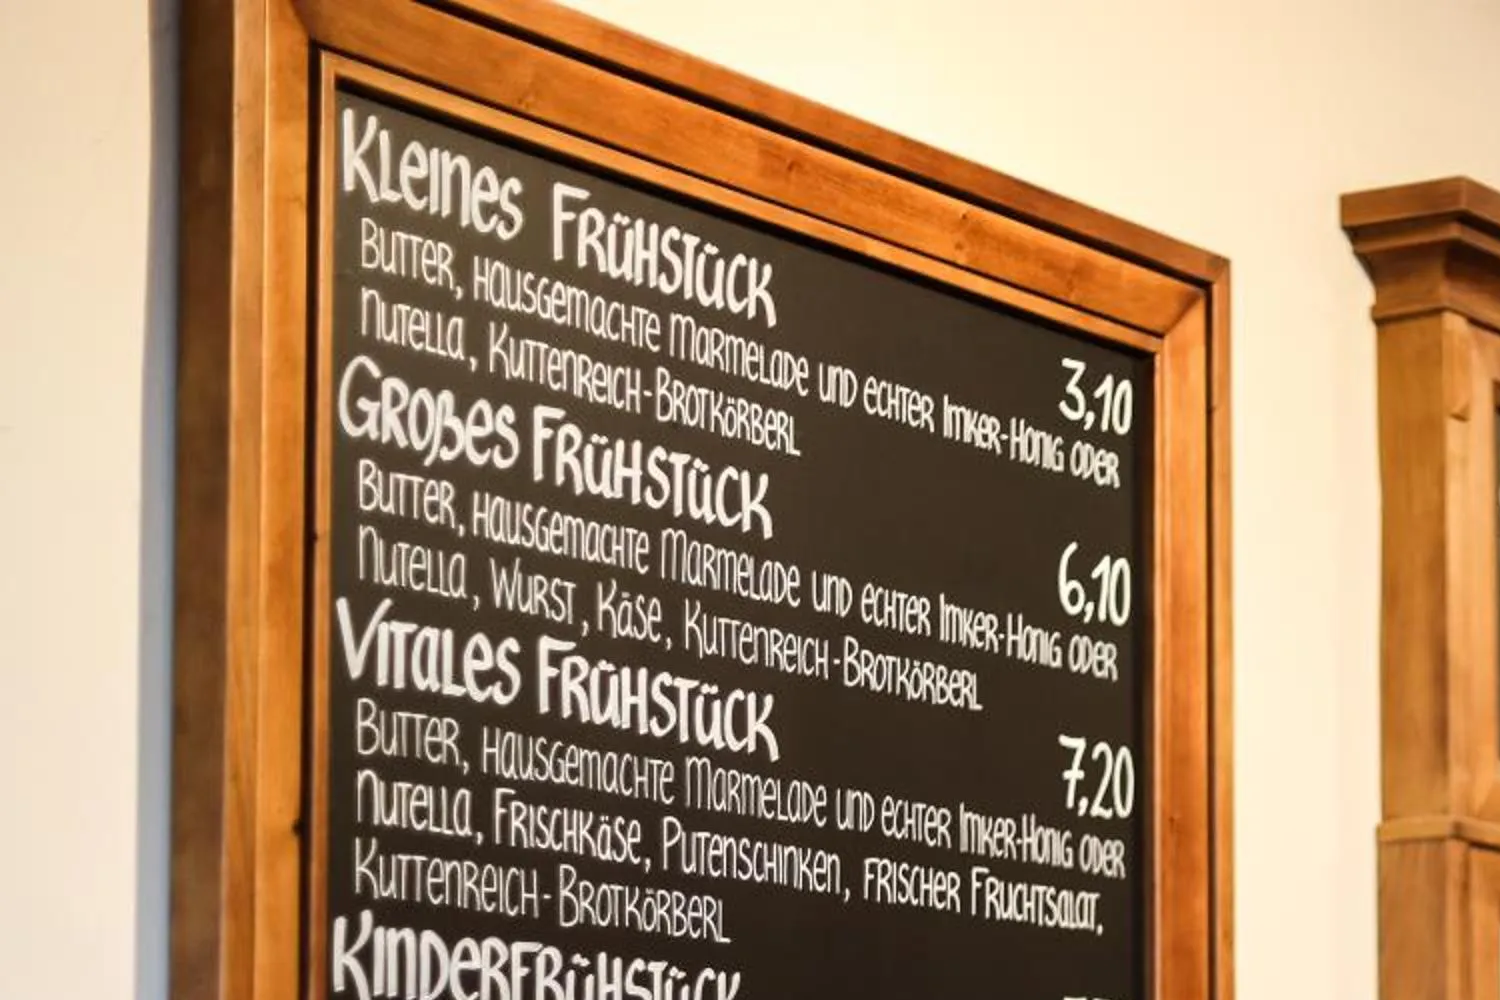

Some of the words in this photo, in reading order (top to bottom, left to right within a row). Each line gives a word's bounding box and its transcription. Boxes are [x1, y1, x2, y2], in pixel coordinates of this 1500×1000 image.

[341, 106, 524, 241] Kleines
[551, 180, 777, 329] Frühstück
[360, 285, 478, 373] Nutella,
[360, 216, 464, 301] Butter,
[472, 254, 661, 353] hausgemachte
[668, 311, 810, 397] Marmelade
[817, 361, 859, 409] und
[862, 374, 935, 434] echter
[942, 392, 1065, 473] Imker-Honig
[1068, 438, 1121, 489] oder
[1057, 356, 1133, 436] 3,10
[337, 353, 521, 470] Großes
[531, 403, 773, 540] Frühstück
[357, 457, 466, 538] Butter,
[471, 489, 650, 575] hausgemachte
[660, 526, 801, 608] Marmelade
[810, 568, 853, 618] und
[859, 581, 932, 637] echter
[938, 591, 1063, 669] Imker-Honig
[1066, 632, 1119, 682] oder
[357, 523, 480, 612] Nutella,
[488, 556, 590, 637] Wurst,
[596, 577, 673, 651] Käse,
[1057, 540, 1132, 627] 6,10
[334, 595, 522, 706] Vitales
[535, 633, 781, 763] Frühstück
[354, 696, 470, 776] Butter,
[481, 725, 675, 805] hausgemachte
[683, 754, 828, 828] Marmelade
[834, 787, 875, 833] und
[879, 794, 952, 849] echter
[958, 800, 1075, 869] Imker-Honig
[1077, 832, 1126, 880] oder
[356, 767, 484, 846] Nutella,
[492, 786, 652, 874] Frischkäse,
[661, 814, 851, 903] Putenschinken,
[862, 855, 961, 913] frischer
[1056, 732, 1135, 820] 7,20
